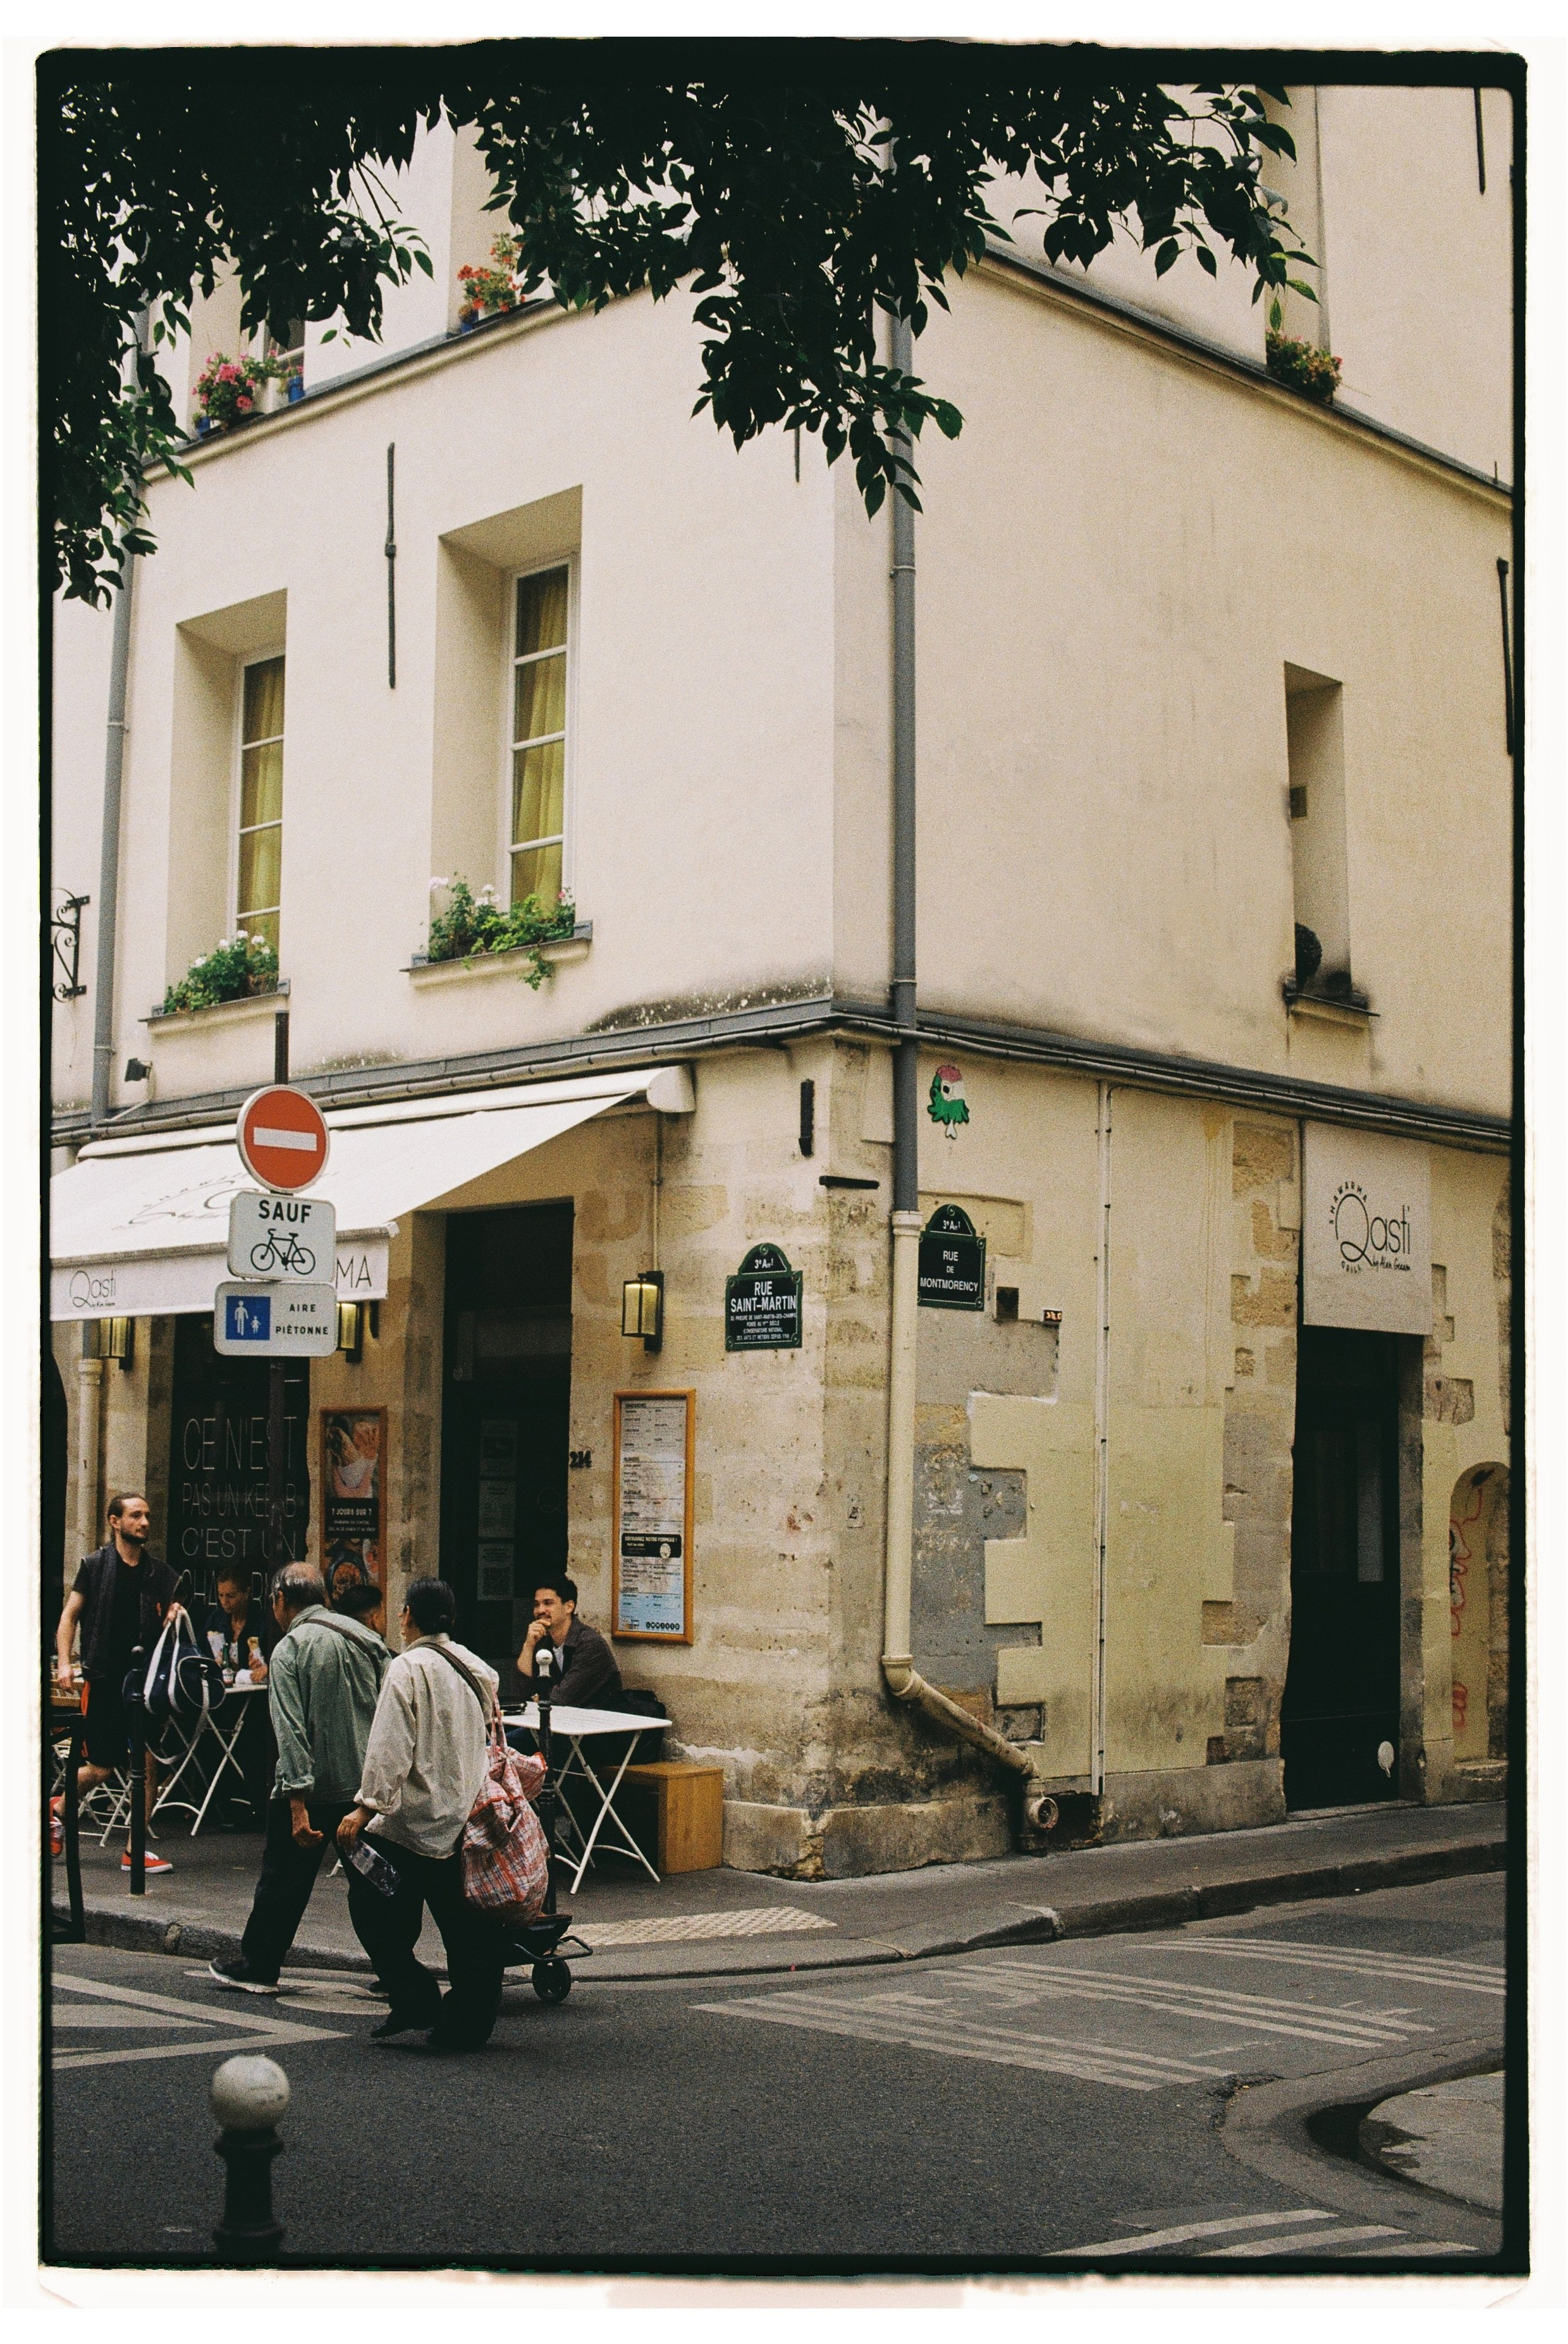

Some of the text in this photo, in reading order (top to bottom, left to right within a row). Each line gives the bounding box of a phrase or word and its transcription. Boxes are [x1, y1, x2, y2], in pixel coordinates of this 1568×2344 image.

[258, 1199, 312, 1223] SAUF
[1335, 1193, 1411, 1267] Qasti
[943, 1250, 959, 1261] RUE
[69, 1270, 116, 1308] Qasti
[754, 1281, 773, 1296] RUE
[920, 1277, 979, 1292] MONTMORENCY
[731, 1295, 796, 1313] SAINT-MARTIN
[184, 1416, 297, 1470] CE N'ET
[183, 1483, 211, 1517] PAS
[217, 1483, 239, 1517] UN
[182, 1527, 252, 1558] C'EST
